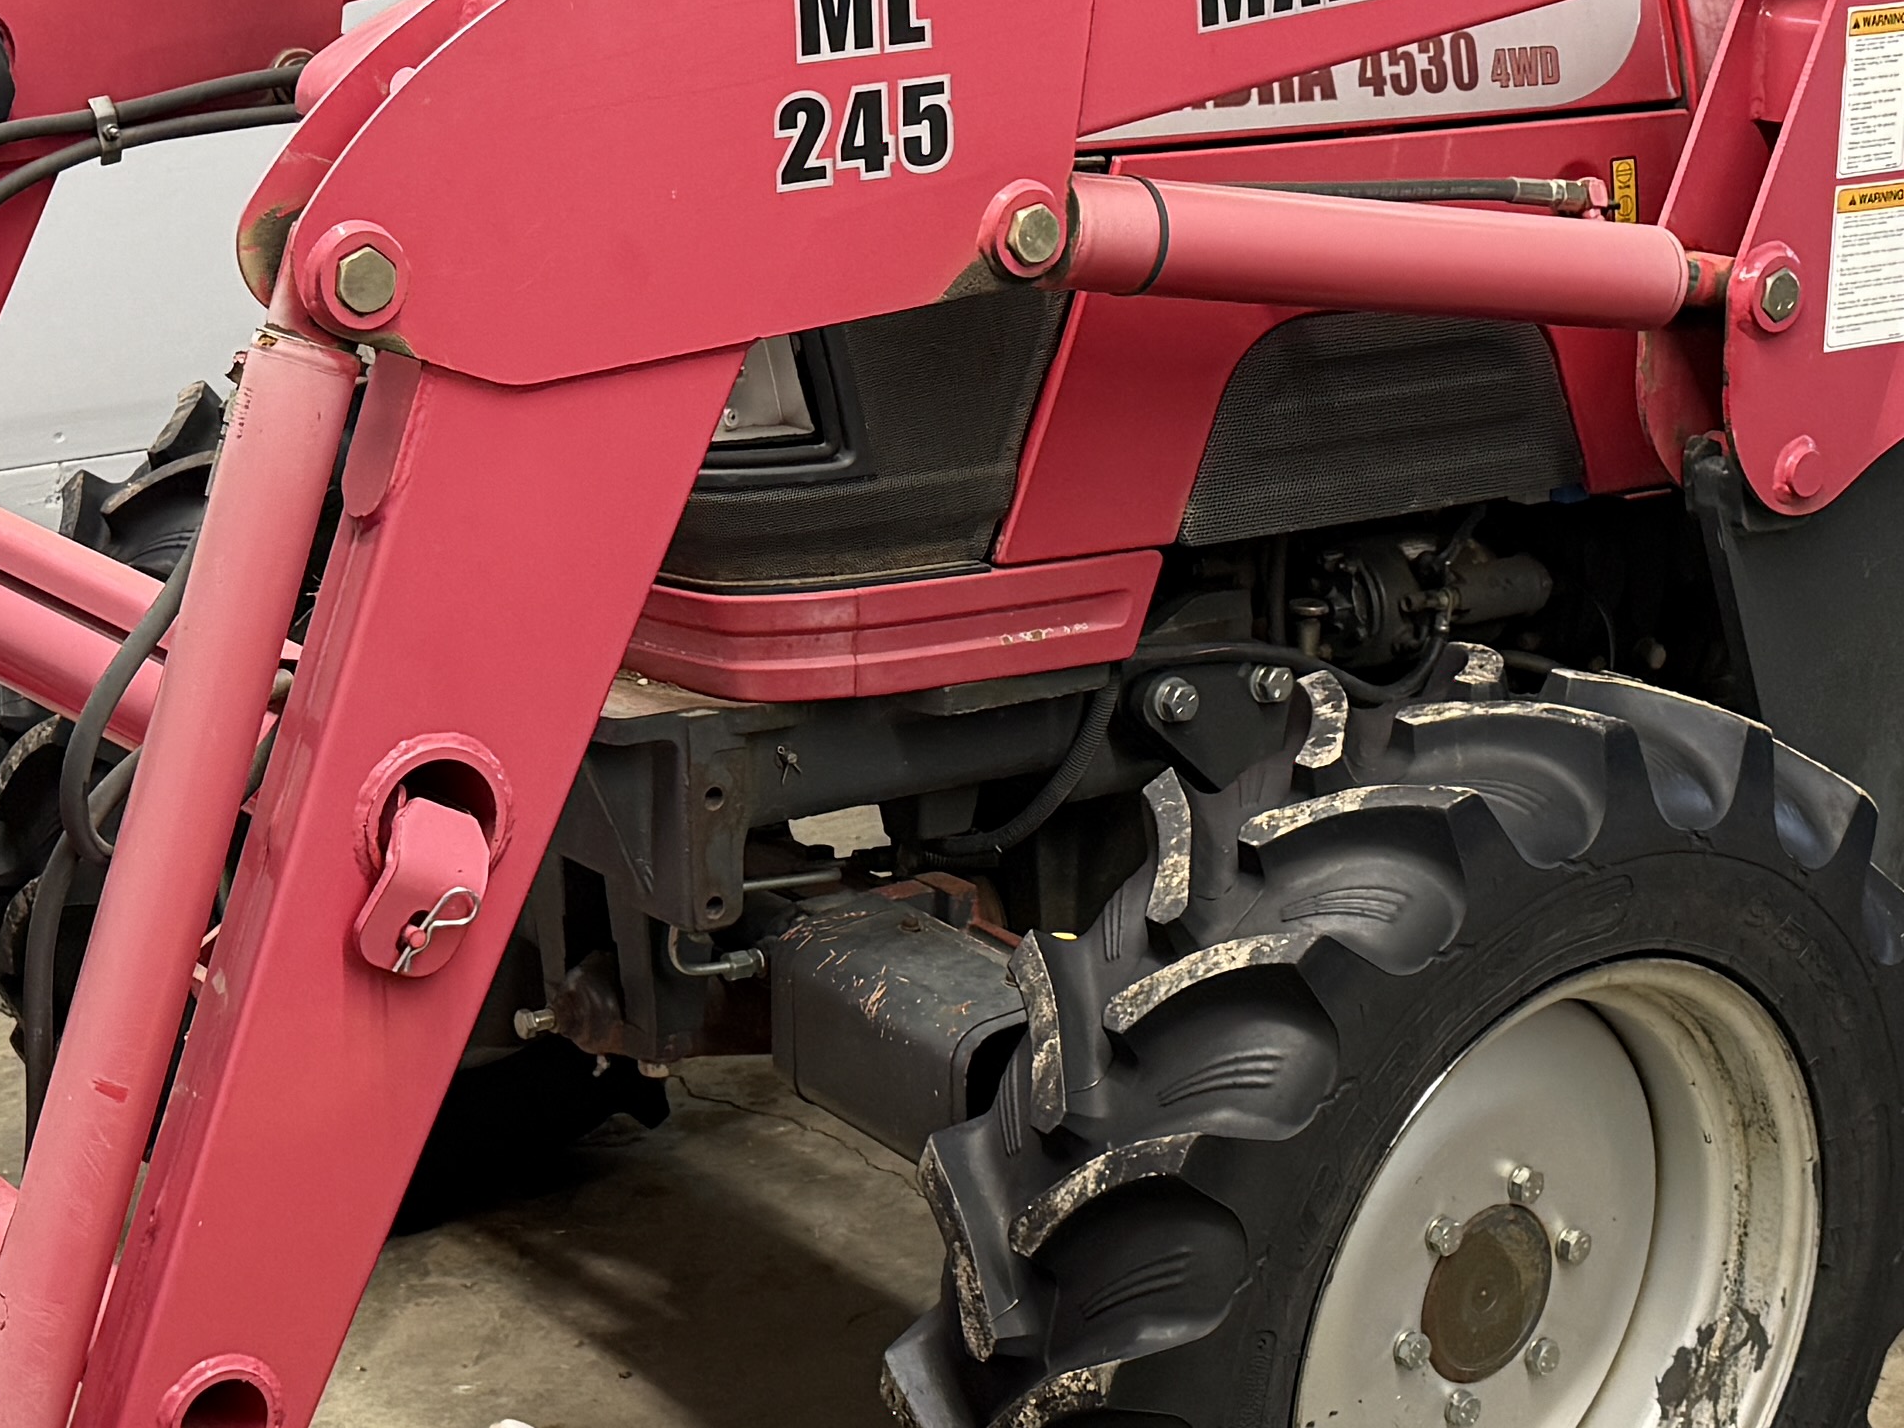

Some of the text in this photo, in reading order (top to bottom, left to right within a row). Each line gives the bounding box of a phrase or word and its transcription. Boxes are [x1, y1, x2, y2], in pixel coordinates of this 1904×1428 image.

[1358, 30, 1480, 99] 4530
[1490, 45, 1560, 89] 4WD
[776, 74, 953, 193] 245
[1858, 189, 1904, 205] WARNING
